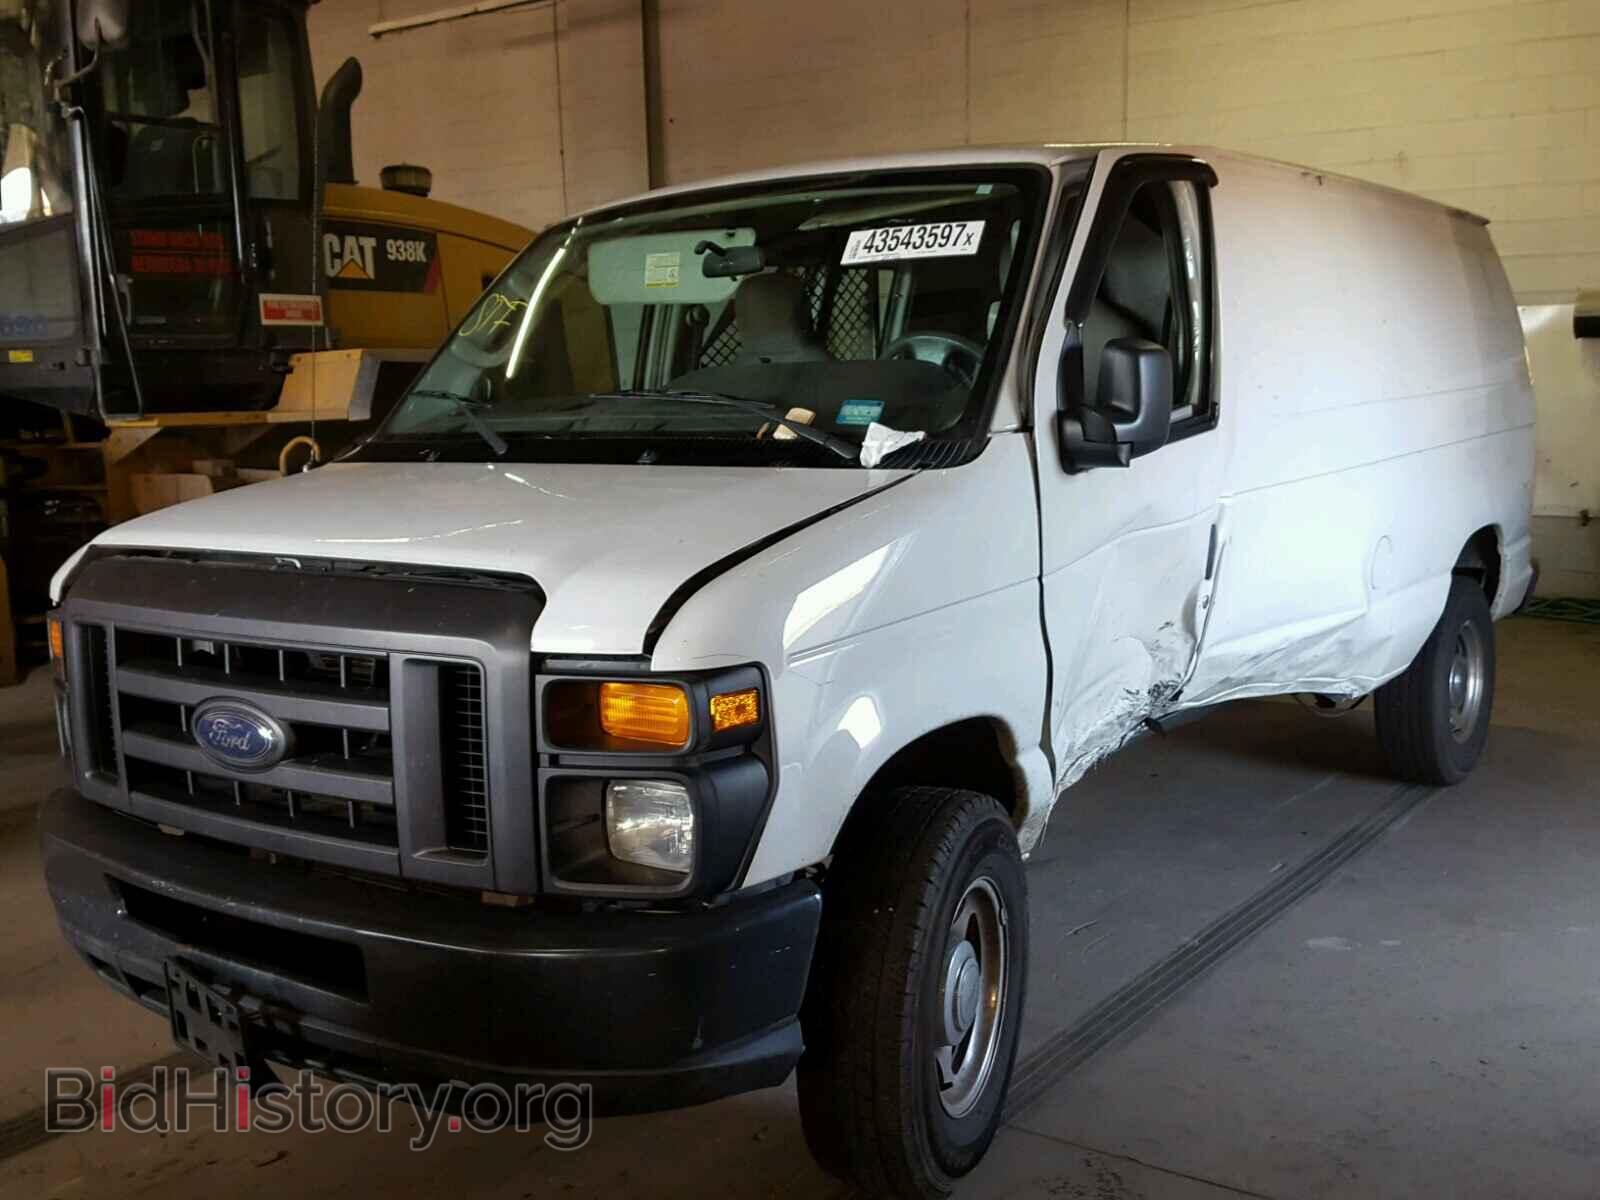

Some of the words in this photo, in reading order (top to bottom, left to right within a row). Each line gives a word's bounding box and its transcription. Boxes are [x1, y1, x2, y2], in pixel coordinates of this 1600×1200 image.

[323, 233, 377, 279] CAT
[386, 239, 427, 262] 938K
[208, 718, 252, 751] Ford
